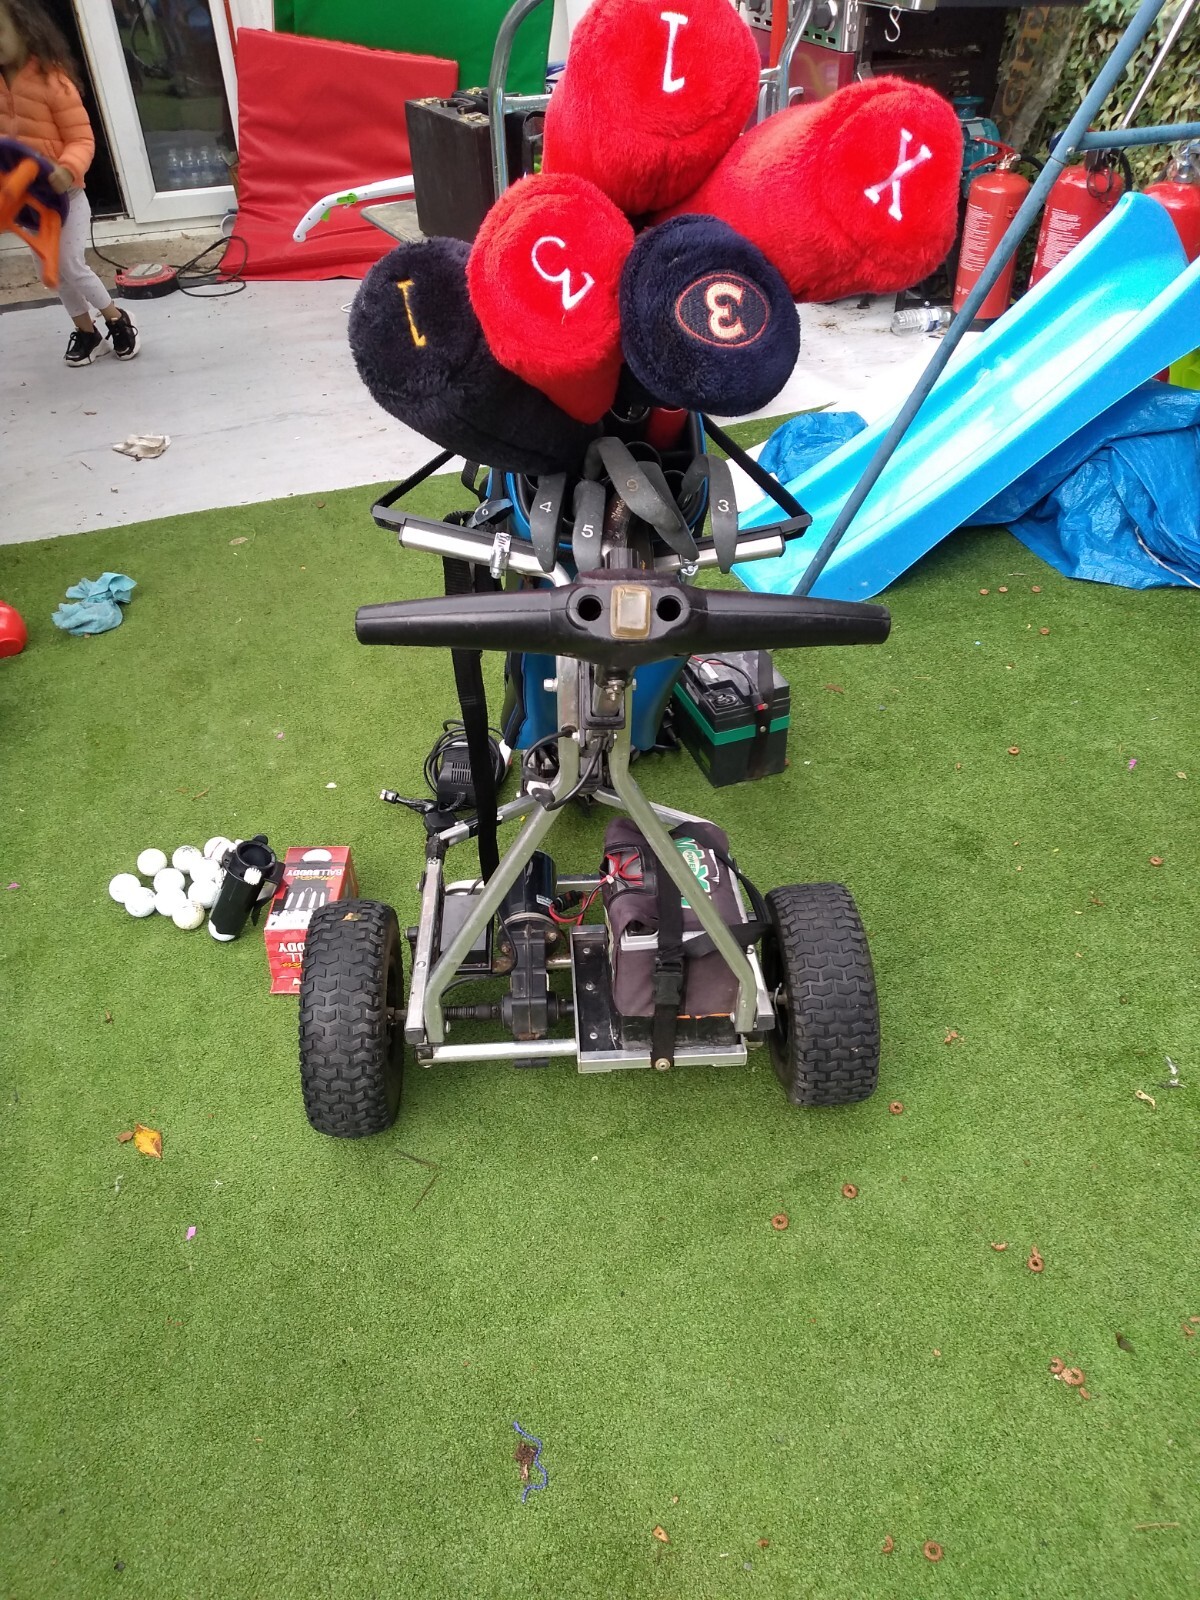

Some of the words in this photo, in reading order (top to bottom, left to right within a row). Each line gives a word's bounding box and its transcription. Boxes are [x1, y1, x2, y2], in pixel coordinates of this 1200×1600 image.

[539, 502, 552, 513] 4
[717, 500, 730, 513] 3
[581, 525, 594, 538] 5
[279, 942, 305, 952] DDY
